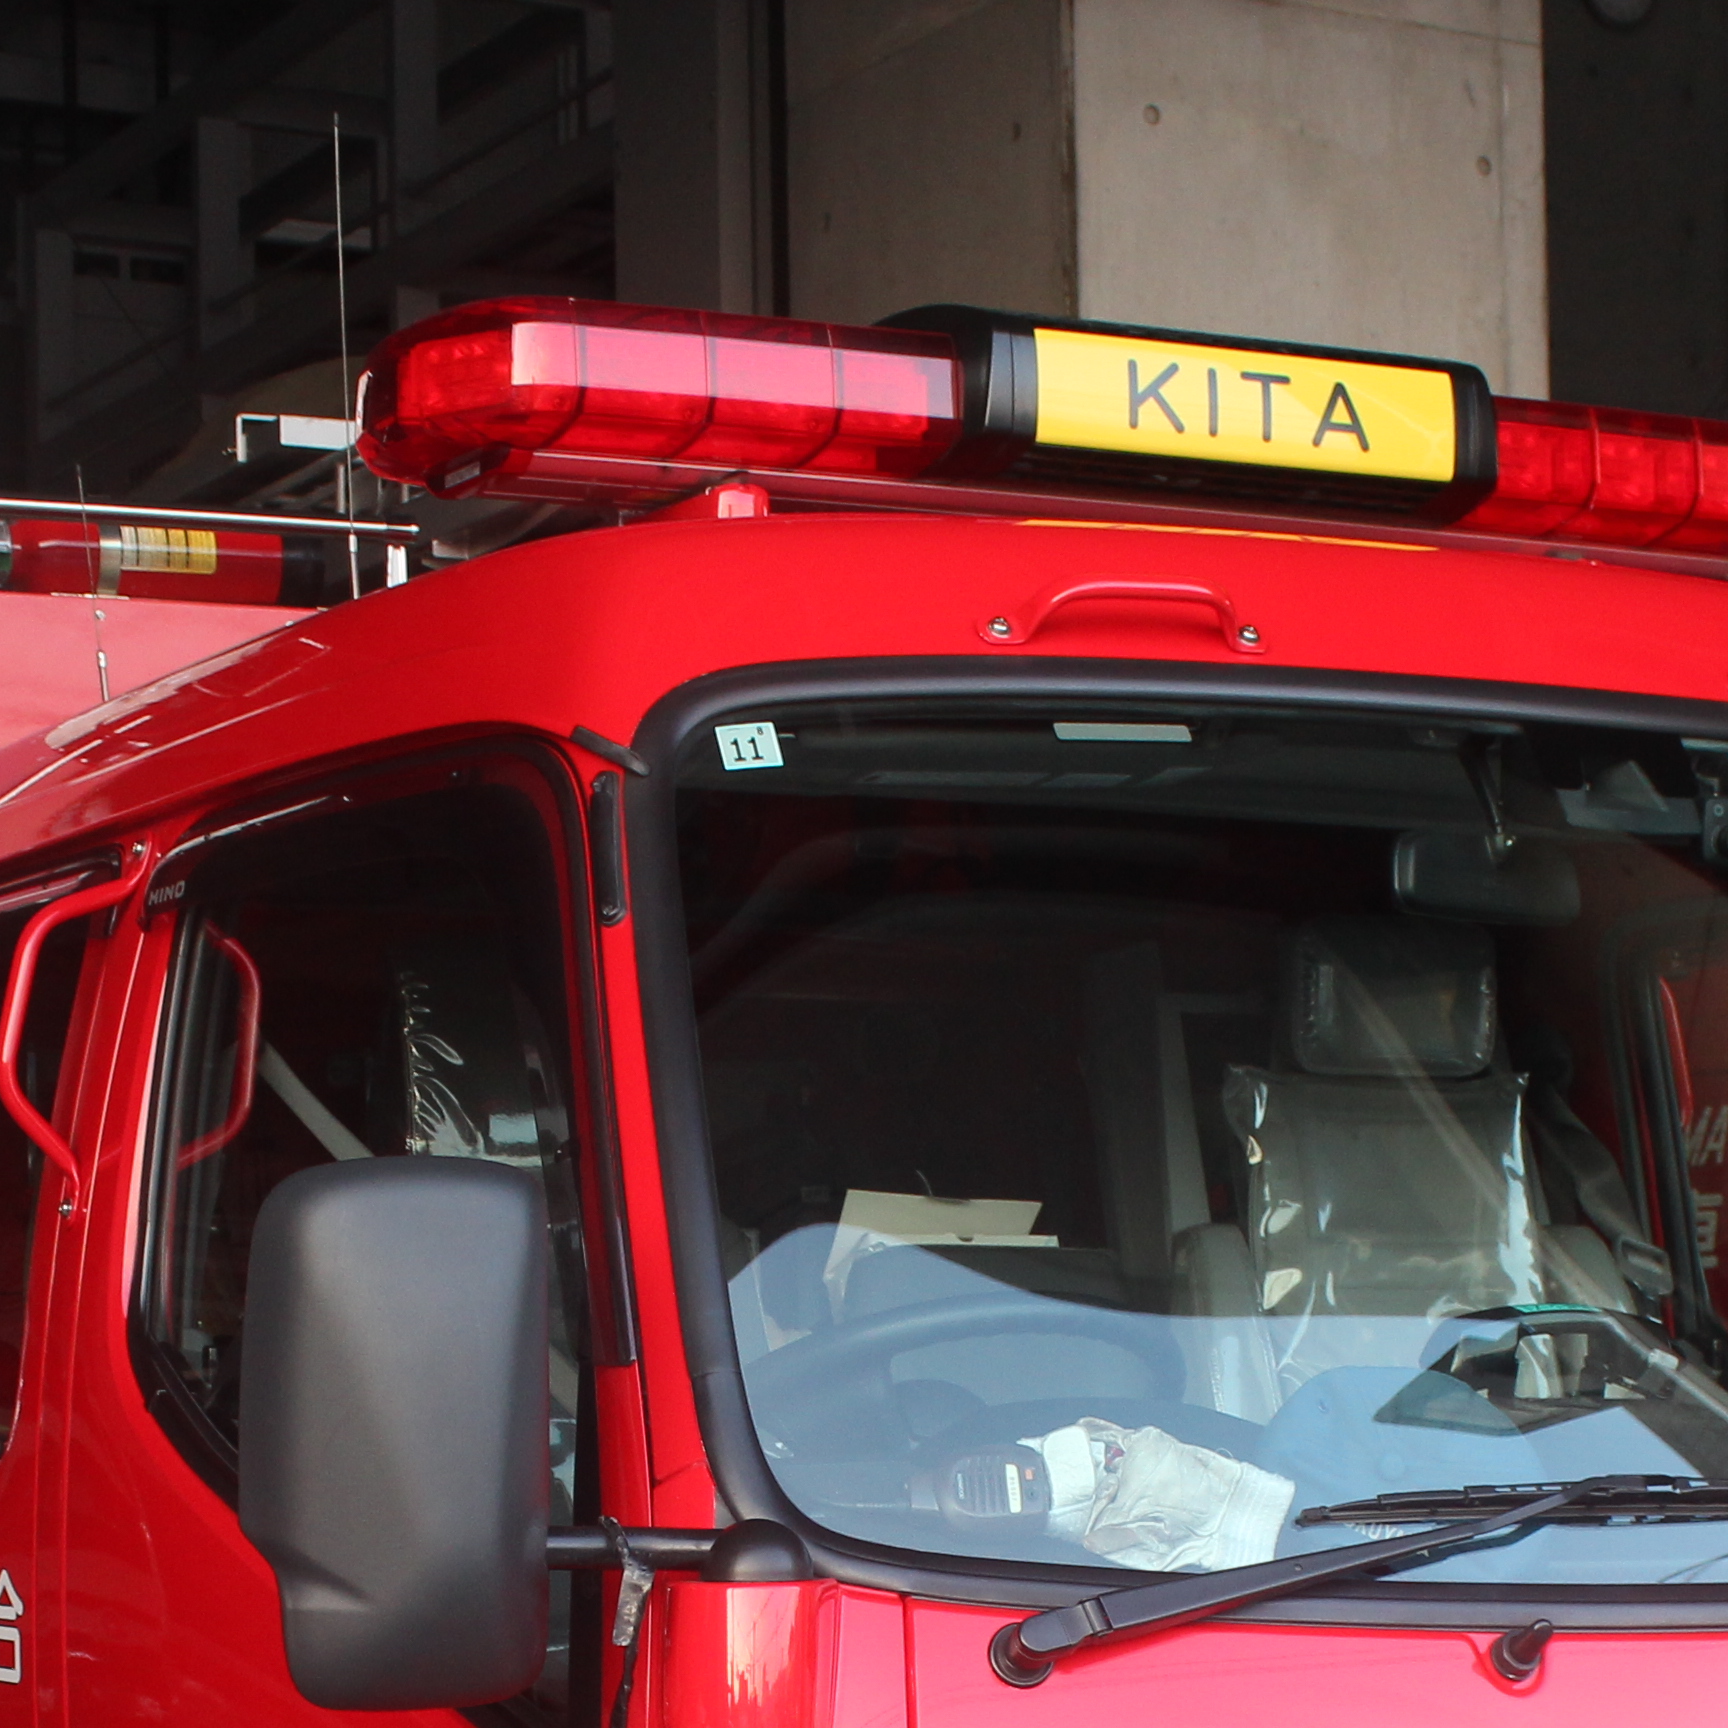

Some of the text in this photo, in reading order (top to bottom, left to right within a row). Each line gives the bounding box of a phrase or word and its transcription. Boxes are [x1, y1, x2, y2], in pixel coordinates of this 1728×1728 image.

[1127, 359, 1370, 452] KITA
[730, 736, 765, 762] 11
[148, 880, 186, 906] HINO
